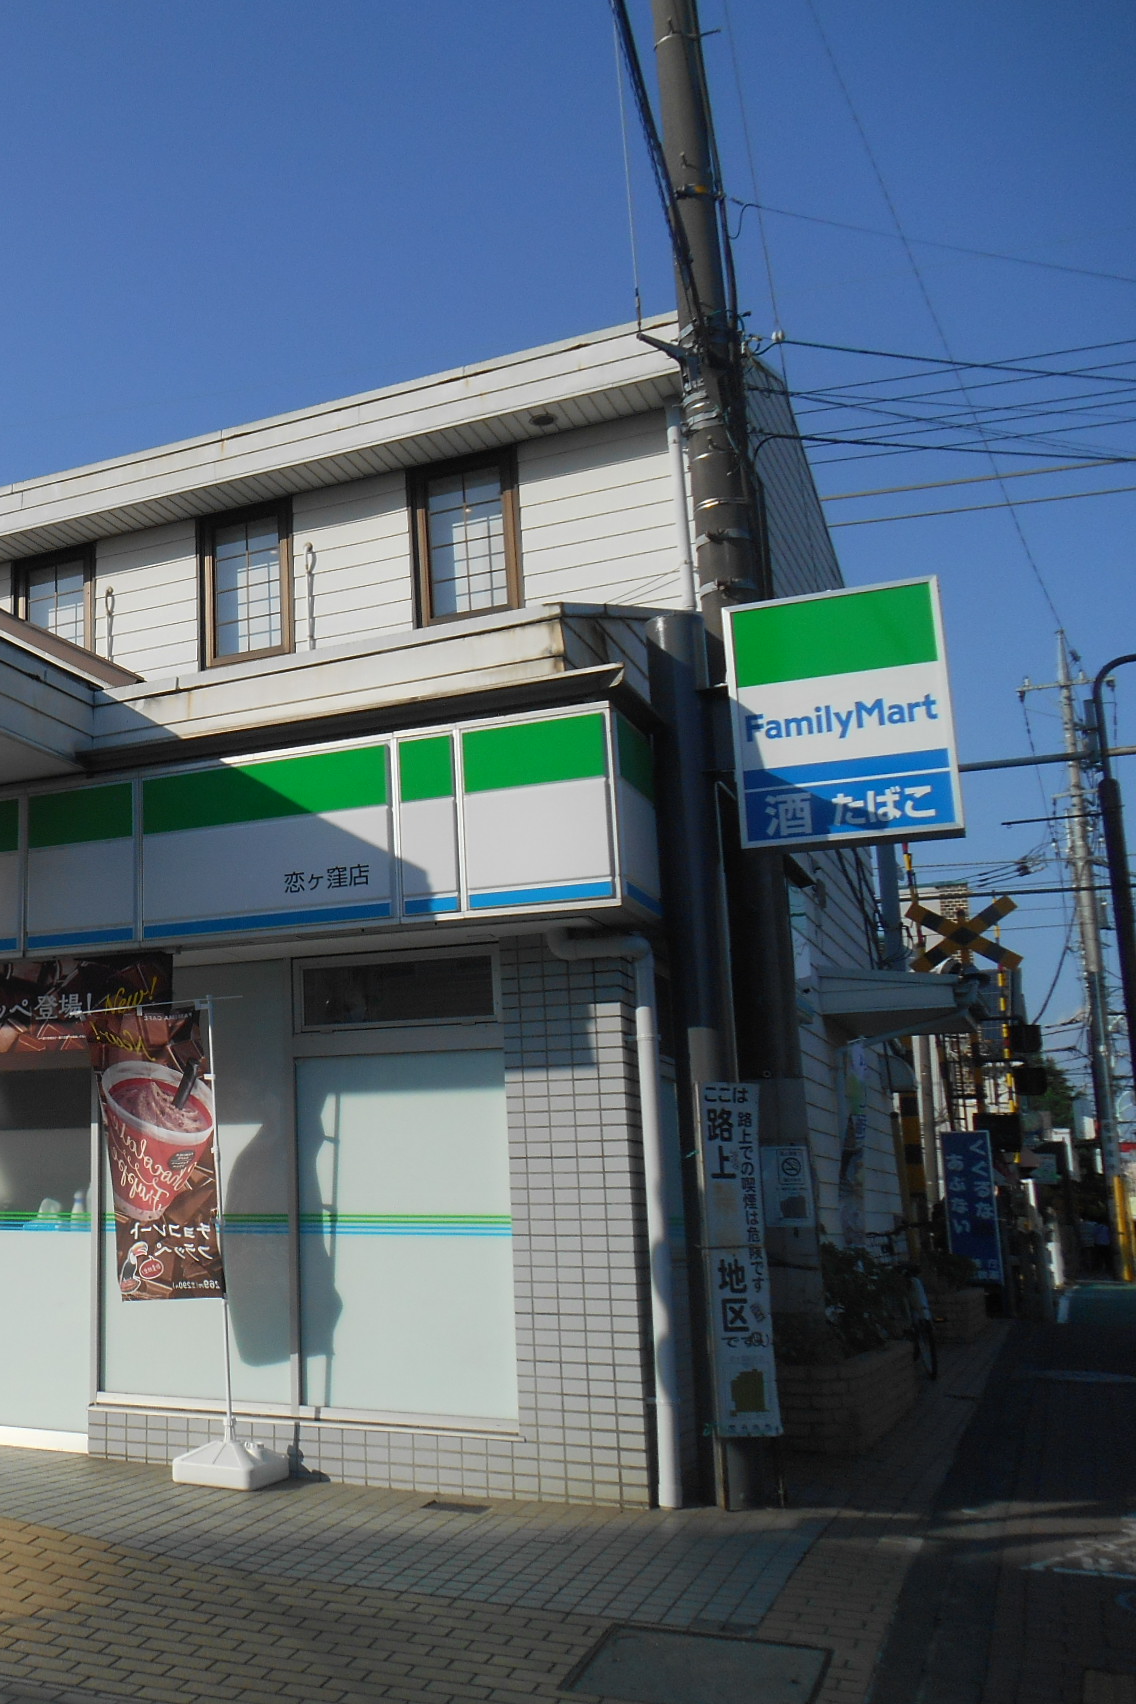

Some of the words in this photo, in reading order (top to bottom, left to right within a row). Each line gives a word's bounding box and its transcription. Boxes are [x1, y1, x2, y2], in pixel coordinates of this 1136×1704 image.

[745, 694, 939, 742] FamilyMart
[765, 792, 813, 837] 酒
[832, 785, 936, 827] たばこ
[105, 976, 157, 1014] New!
[704, 1087, 749, 1103] ここは
[707, 1108, 737, 1179] 路上
[945, 1153, 971, 1234] あぶない
[718, 1258, 749, 1332] 地区
